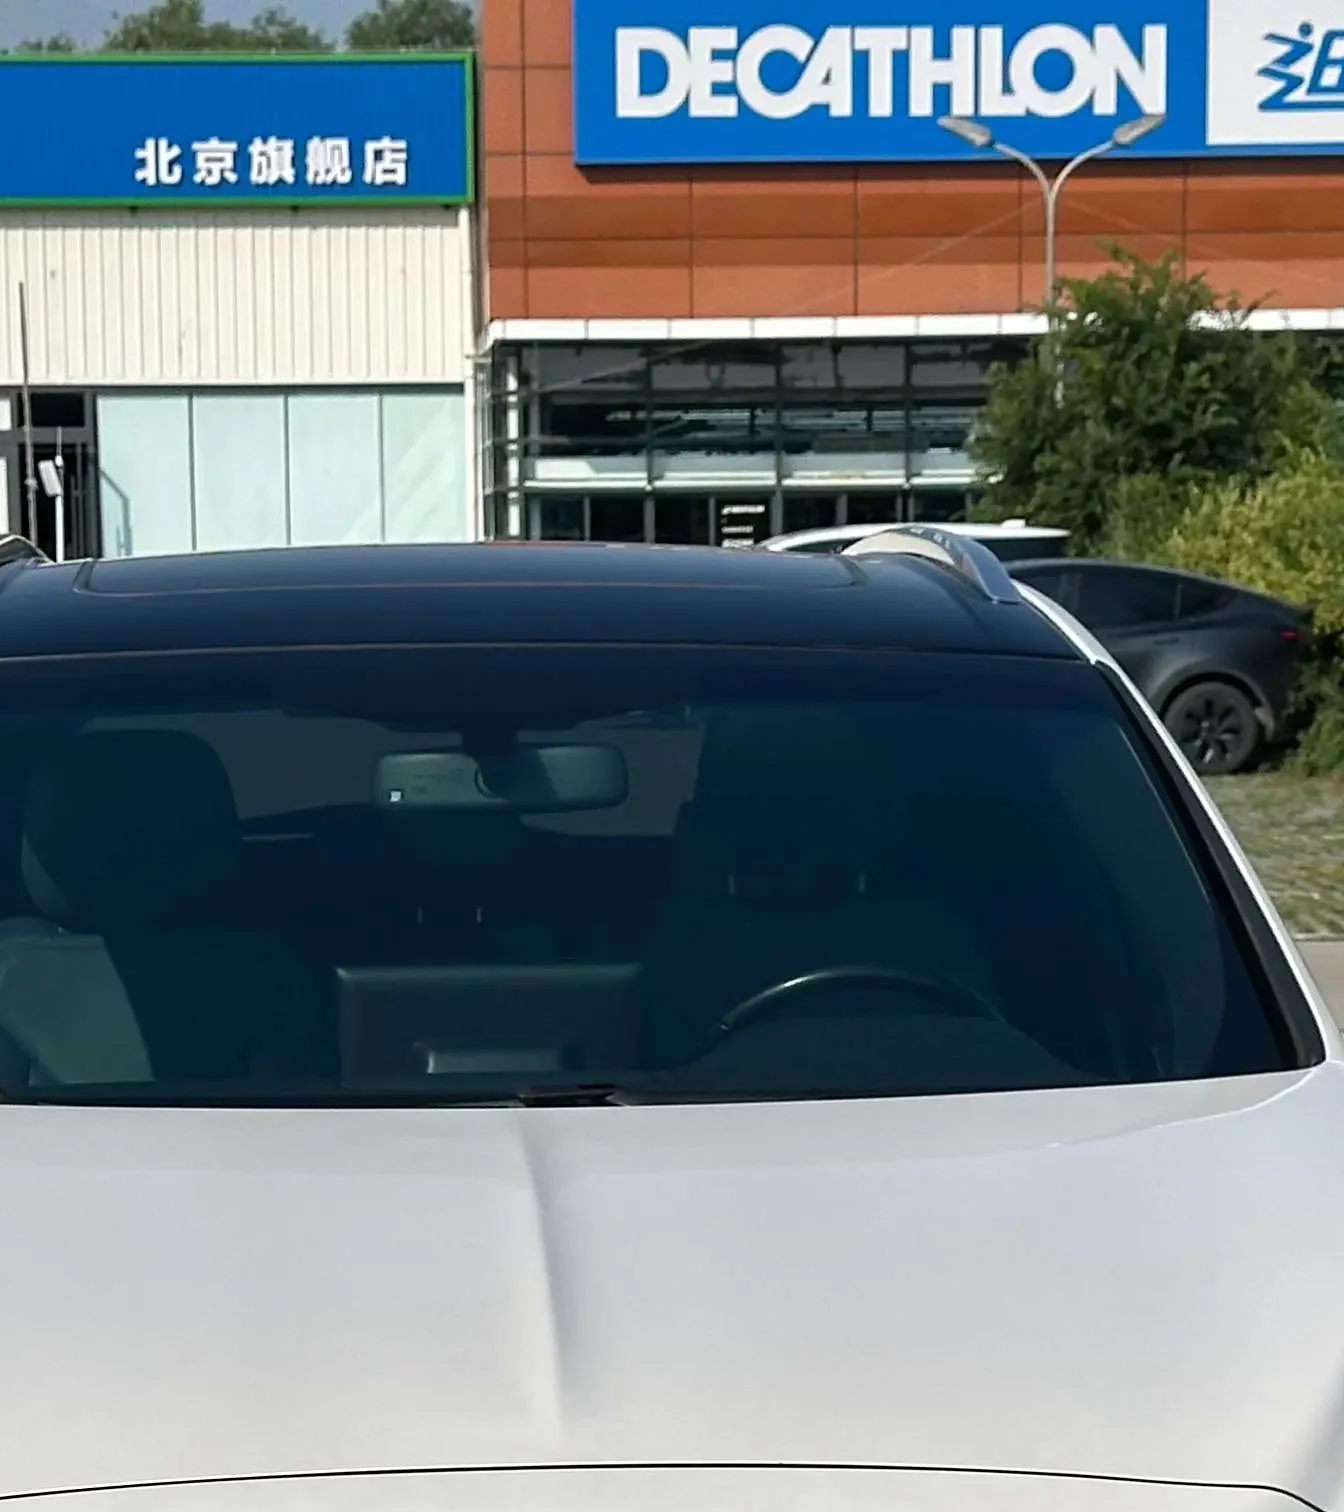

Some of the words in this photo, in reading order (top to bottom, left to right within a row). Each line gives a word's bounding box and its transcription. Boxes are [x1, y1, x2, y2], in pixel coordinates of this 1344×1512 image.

[614, 22, 1168, 119] DECATHLON
[133, 136, 409, 188] 北京旗舰店
